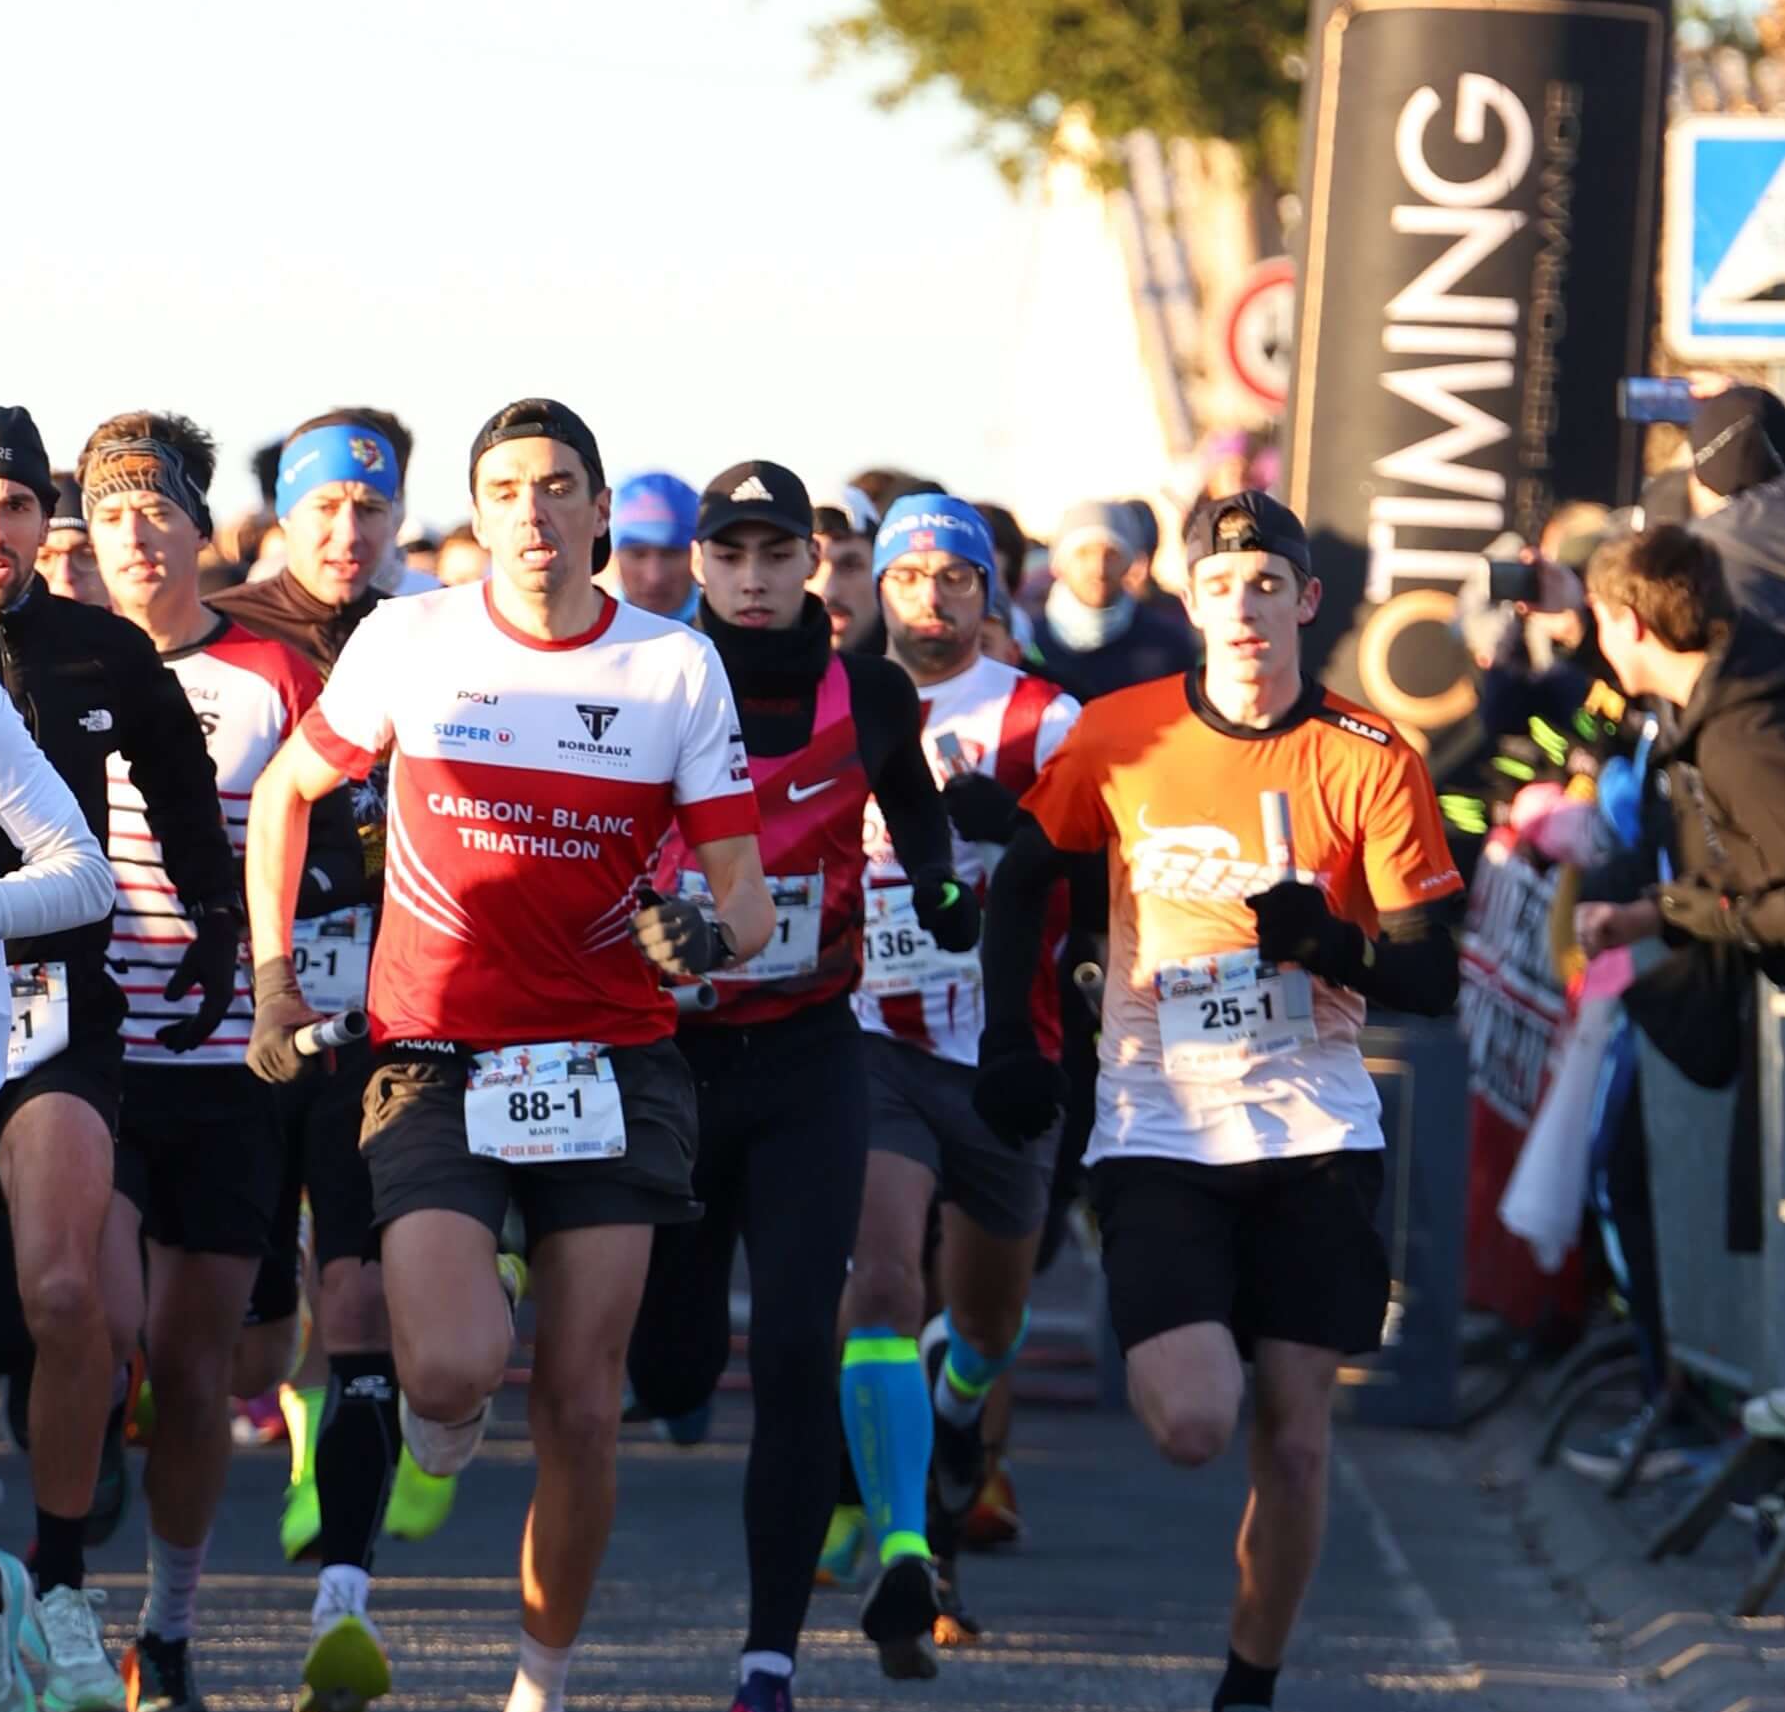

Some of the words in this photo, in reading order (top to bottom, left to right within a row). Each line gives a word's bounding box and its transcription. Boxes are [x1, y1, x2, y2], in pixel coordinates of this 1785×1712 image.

[457, 691, 499, 705] POLI
[433, 722, 491, 741] SUPER
[558, 740, 632, 757] BORDEAUX
[427, 792, 533, 824] CARBON
[551, 808, 634, 837] BLANC
[457, 827, 600, 860] TRIATHLON
[1200, 993, 1273, 1029] 25-1
[508, 1088, 583, 1123] 88-1
[529, 1126, 569, 1136] MARTIN
